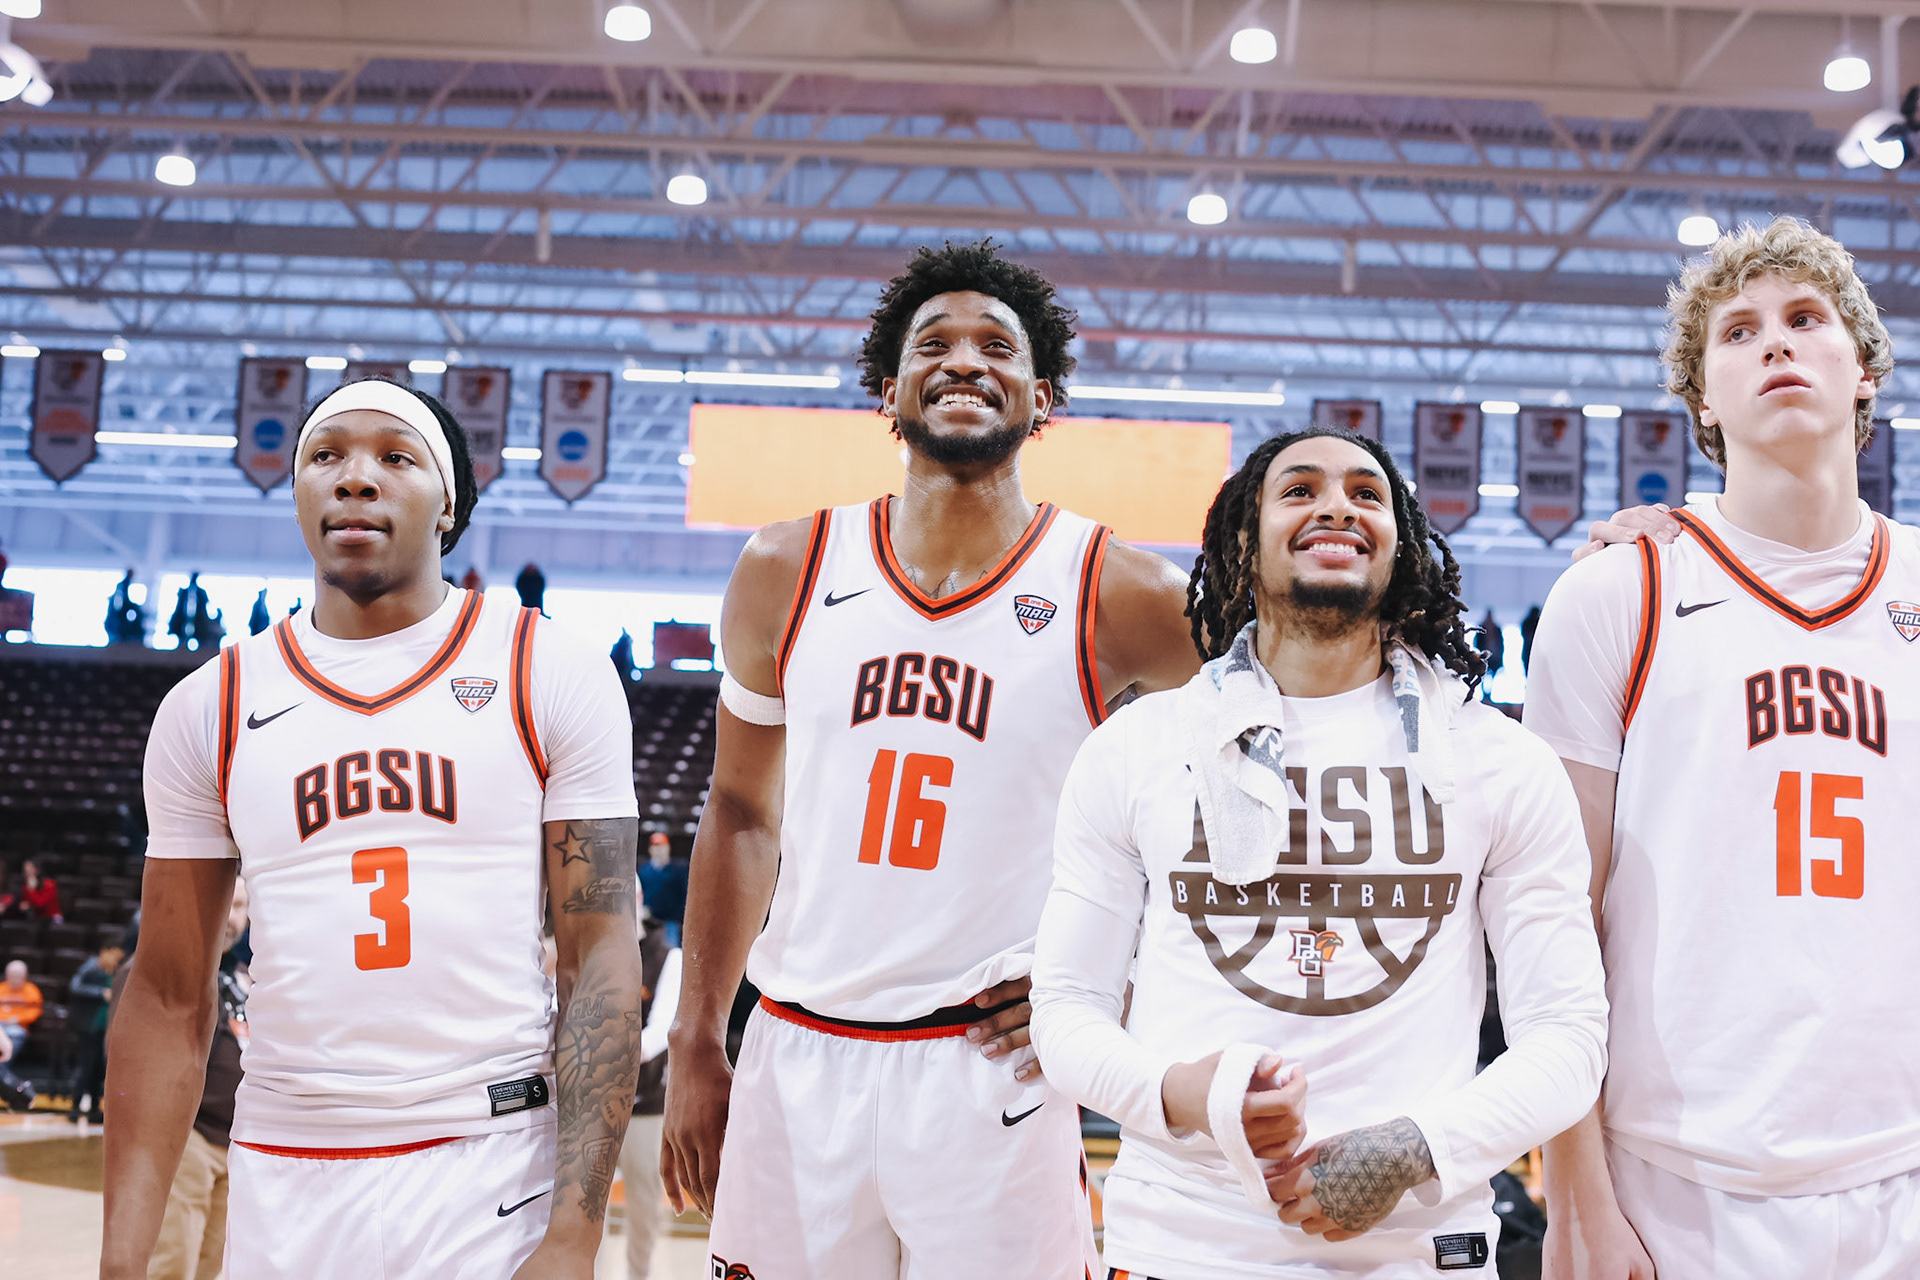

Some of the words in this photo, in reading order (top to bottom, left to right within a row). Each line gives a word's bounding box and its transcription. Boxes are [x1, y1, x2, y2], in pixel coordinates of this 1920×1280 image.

[850, 652, 994, 743] BGSU
[1744, 664, 1887, 758] BGSU
[293, 748, 457, 843] BGSU
[858, 748, 954, 870] 16
[1183, 765, 1444, 865] SU
[1773, 770, 1864, 899] 15
[351, 846, 411, 971] 3
[1175, 880, 1455, 907] BASKETBALL
[533, 1085, 541, 1098] S
[1476, 1243, 1482, 1257] L
